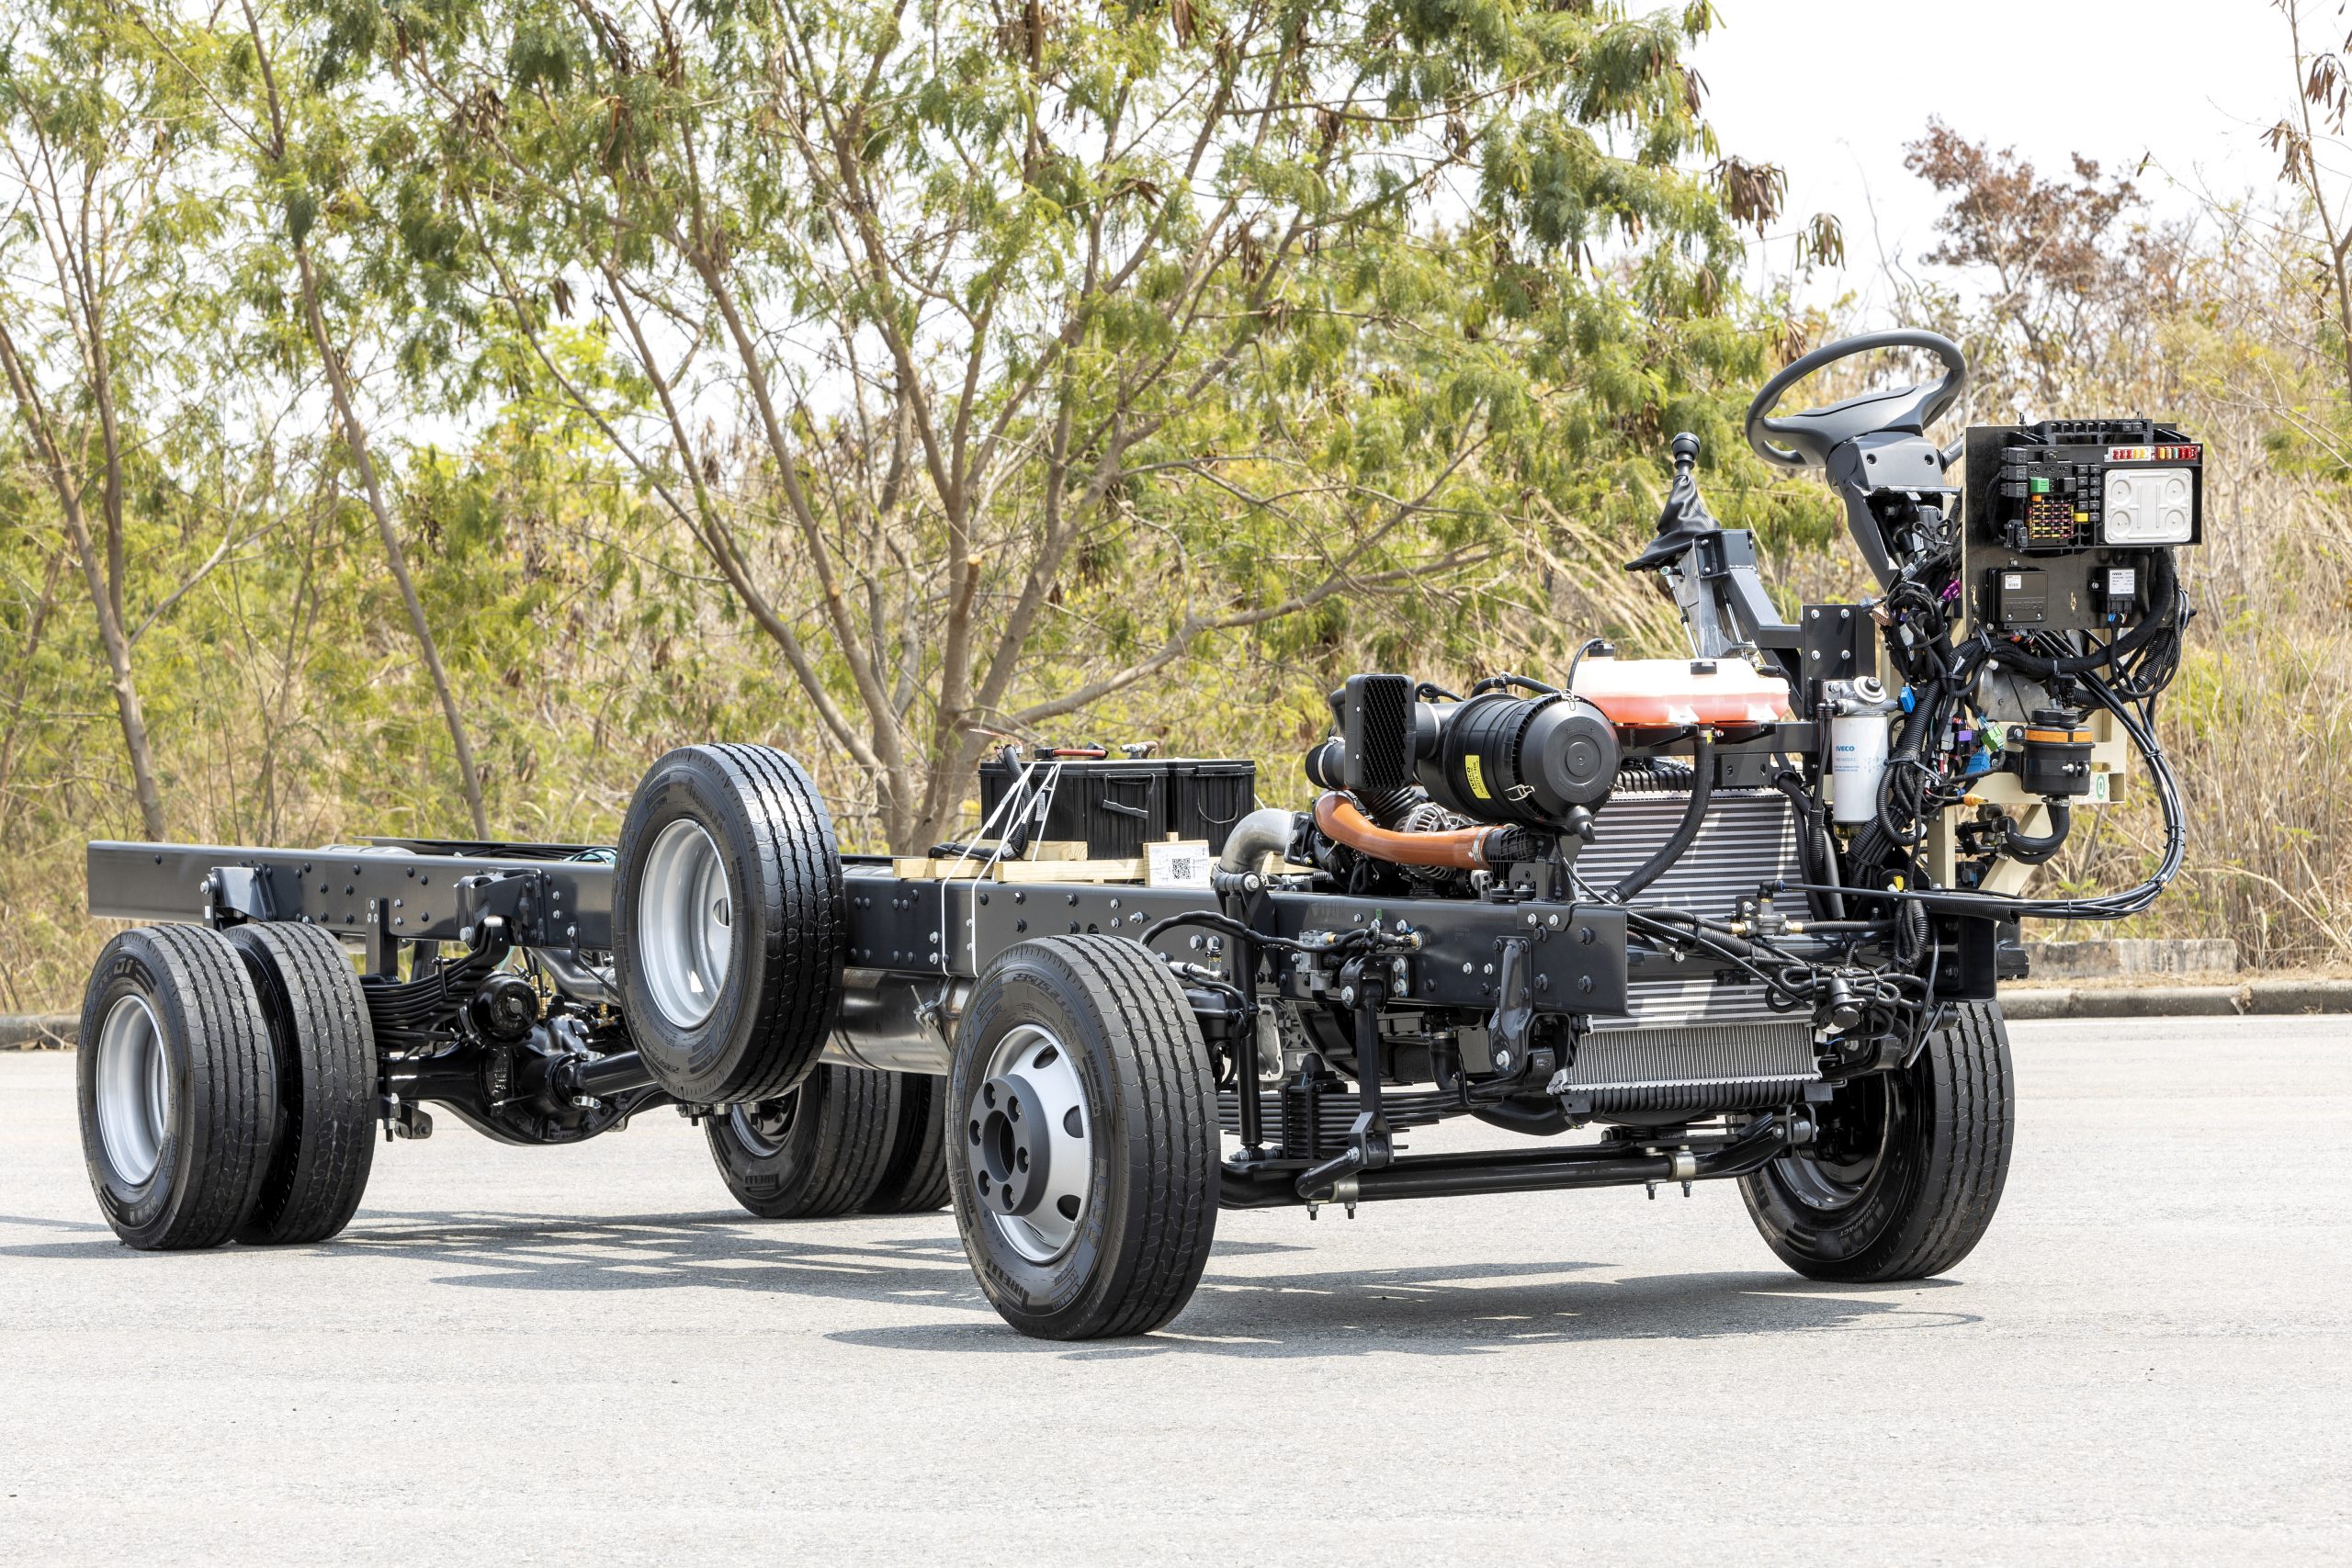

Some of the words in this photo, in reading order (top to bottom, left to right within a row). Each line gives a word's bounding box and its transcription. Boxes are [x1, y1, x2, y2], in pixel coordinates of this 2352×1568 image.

[1466, 767, 1476, 790] IVECO
[1839, 1196, 1880, 1237] ECOIMPACT
[985, 1257, 1029, 1314] PIRELLI
